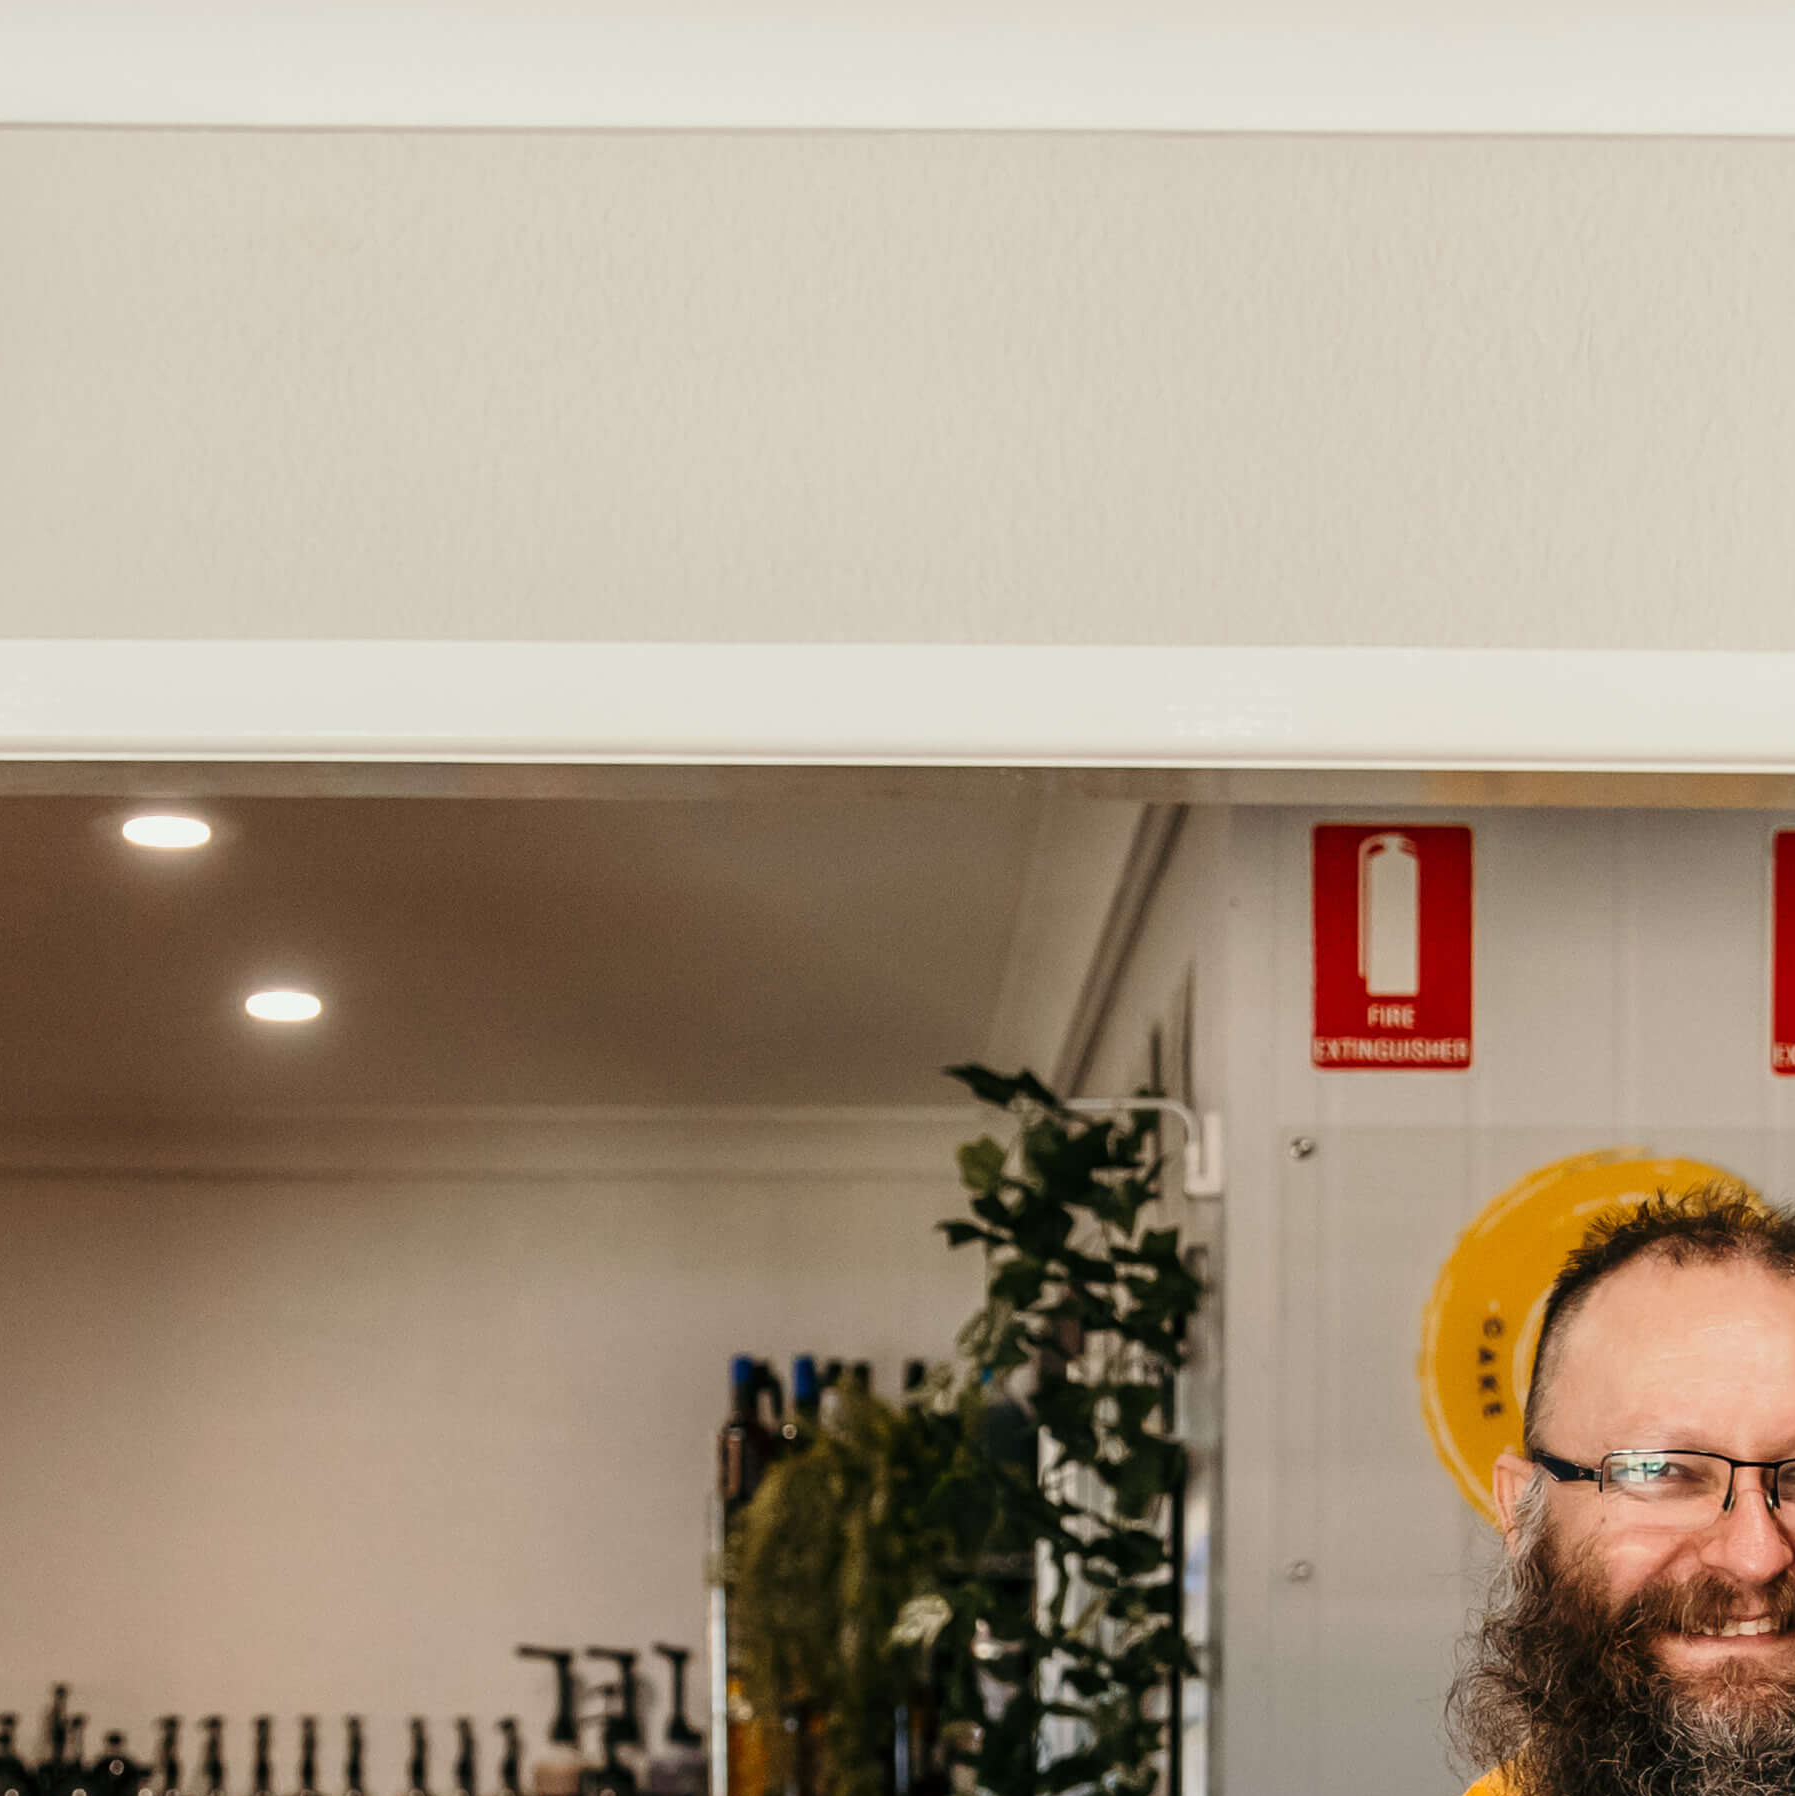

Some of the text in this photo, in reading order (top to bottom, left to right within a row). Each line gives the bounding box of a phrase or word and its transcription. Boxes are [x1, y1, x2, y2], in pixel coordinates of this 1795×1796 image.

[1367, 1003, 1415, 1029] FIRE
[1313, 1036, 1468, 1062] EXTINGUISHER
[1479, 1315, 1504, 1419] CAKE
